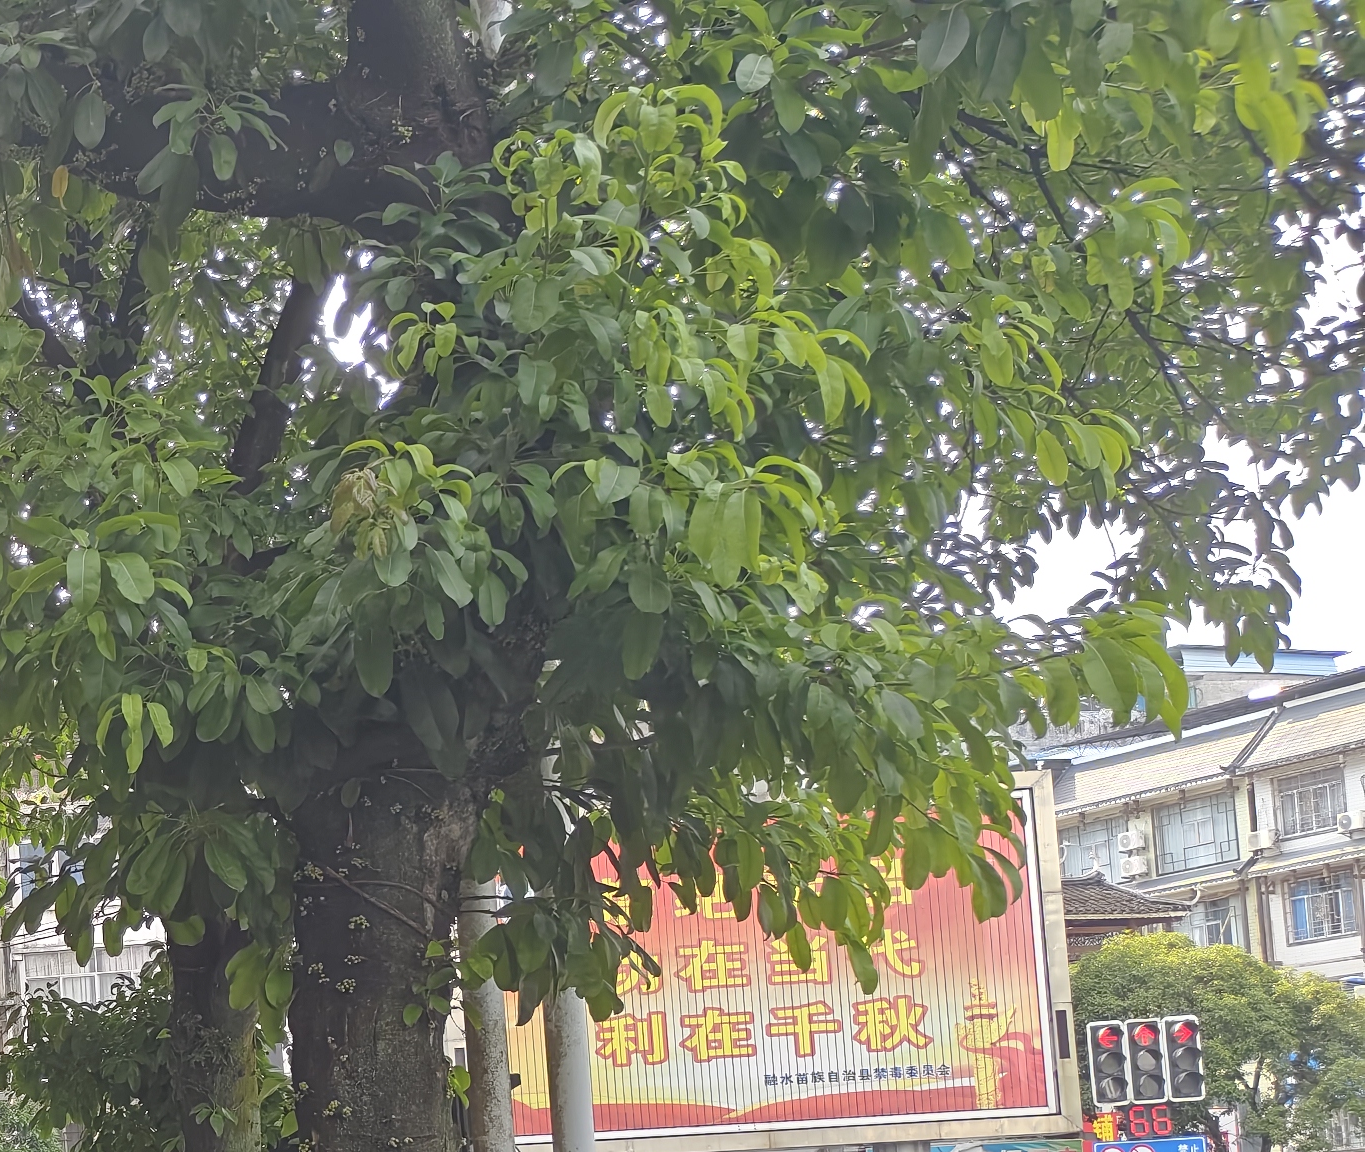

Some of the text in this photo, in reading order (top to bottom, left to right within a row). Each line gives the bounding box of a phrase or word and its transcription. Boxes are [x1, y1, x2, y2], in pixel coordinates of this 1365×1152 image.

[595, 995, 933, 1067] 利在千秋
[764, 1064, 950, 1086] 融水苗族自治县禁毒委员会
[1129, 1105, 1172, 1136] 66
